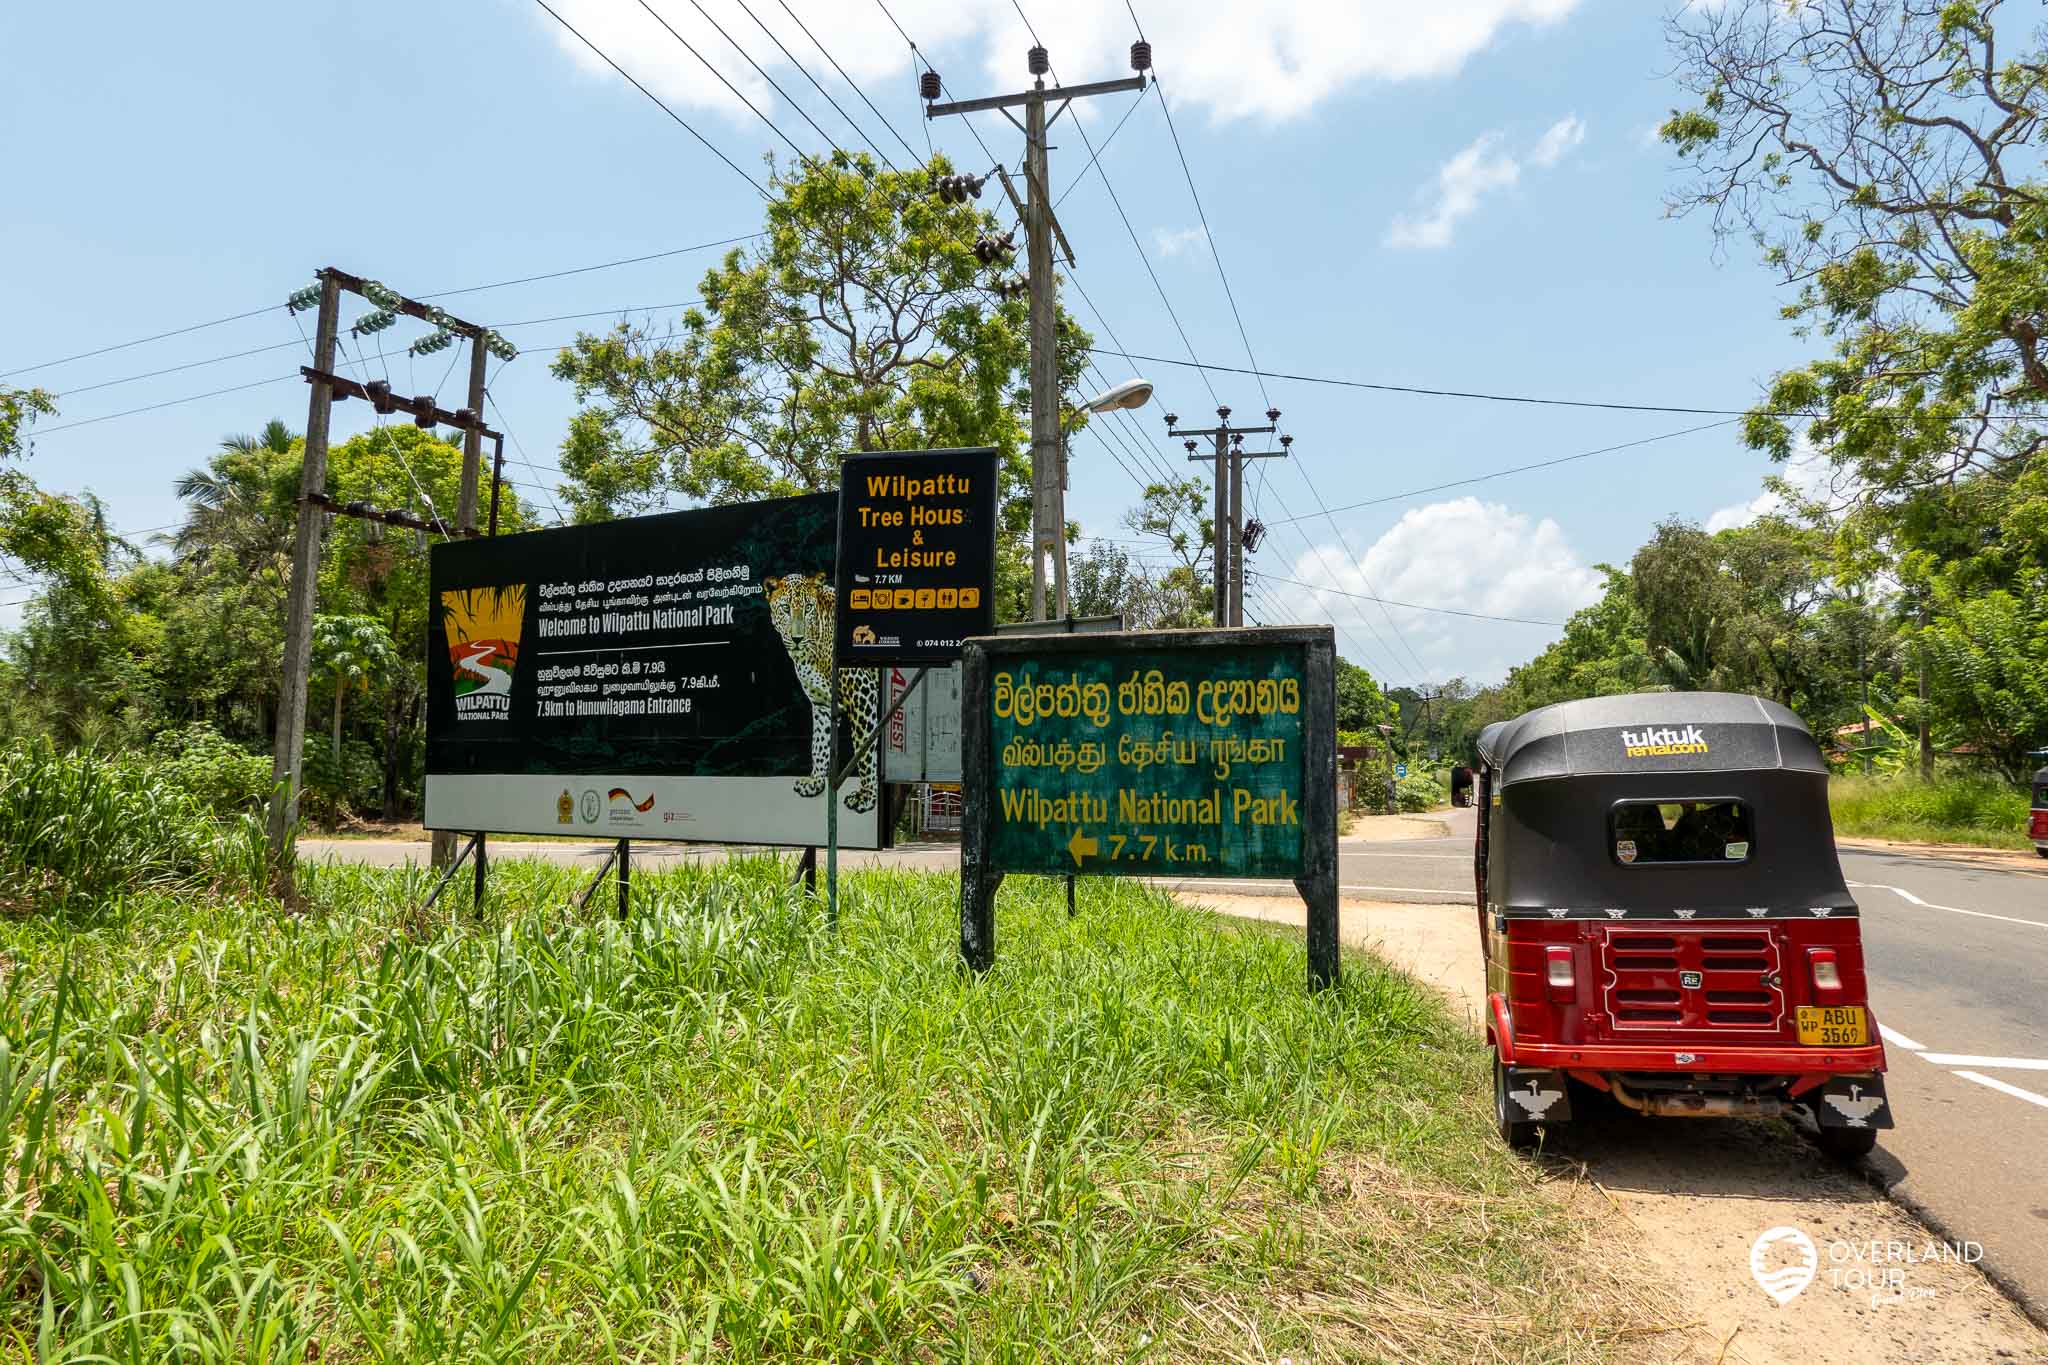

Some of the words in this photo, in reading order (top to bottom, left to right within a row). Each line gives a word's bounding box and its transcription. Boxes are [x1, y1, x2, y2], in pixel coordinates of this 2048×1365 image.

[867, 474, 970, 501] Wilpattu
[858, 506, 904, 528] Tree
[912, 529, 924, 545] &
[877, 548, 957, 568] Leisure
[875, 574, 887, 584] 7.7
[888, 574, 903, 584] KM
[539, 617, 587, 638] Welcome
[589, 615, 600, 634] to
[602, 611, 650, 635] Wilpattu
[653, 606, 703, 630] National
[705, 603, 734, 626] Park
[924, 639, 939, 648] 074
[940, 639, 954, 648] 012
[456, 695, 511, 711] WILPATTU
[1118, 670, 1190, 716] ජාතික
[457, 711, 490, 721] NATIONAL
[491, 711, 509, 720] PARK
[537, 700, 564, 717] 7.9km
[565, 700, 575, 716] to
[576, 698, 645, 717] Hunuwilagama
[647, 697, 692, 714] Entrance
[1621, 724, 1705, 747] tuktuk
[1003, 735, 1106, 774] வில்பத்து
[1118, 731, 1196, 774] தேசிய
[1626, 741, 1709, 758] rental.com
[1000, 788, 1107, 830] Wilpattu
[1119, 788, 1220, 825] National
[1233, 788, 1298, 825] Park
[1108, 834, 1157, 861] 7.7
[1164, 836, 1212, 862] k.m.
[1801, 1021, 1817, 1032] WP
[1823, 1009, 1856, 1025] ABU
